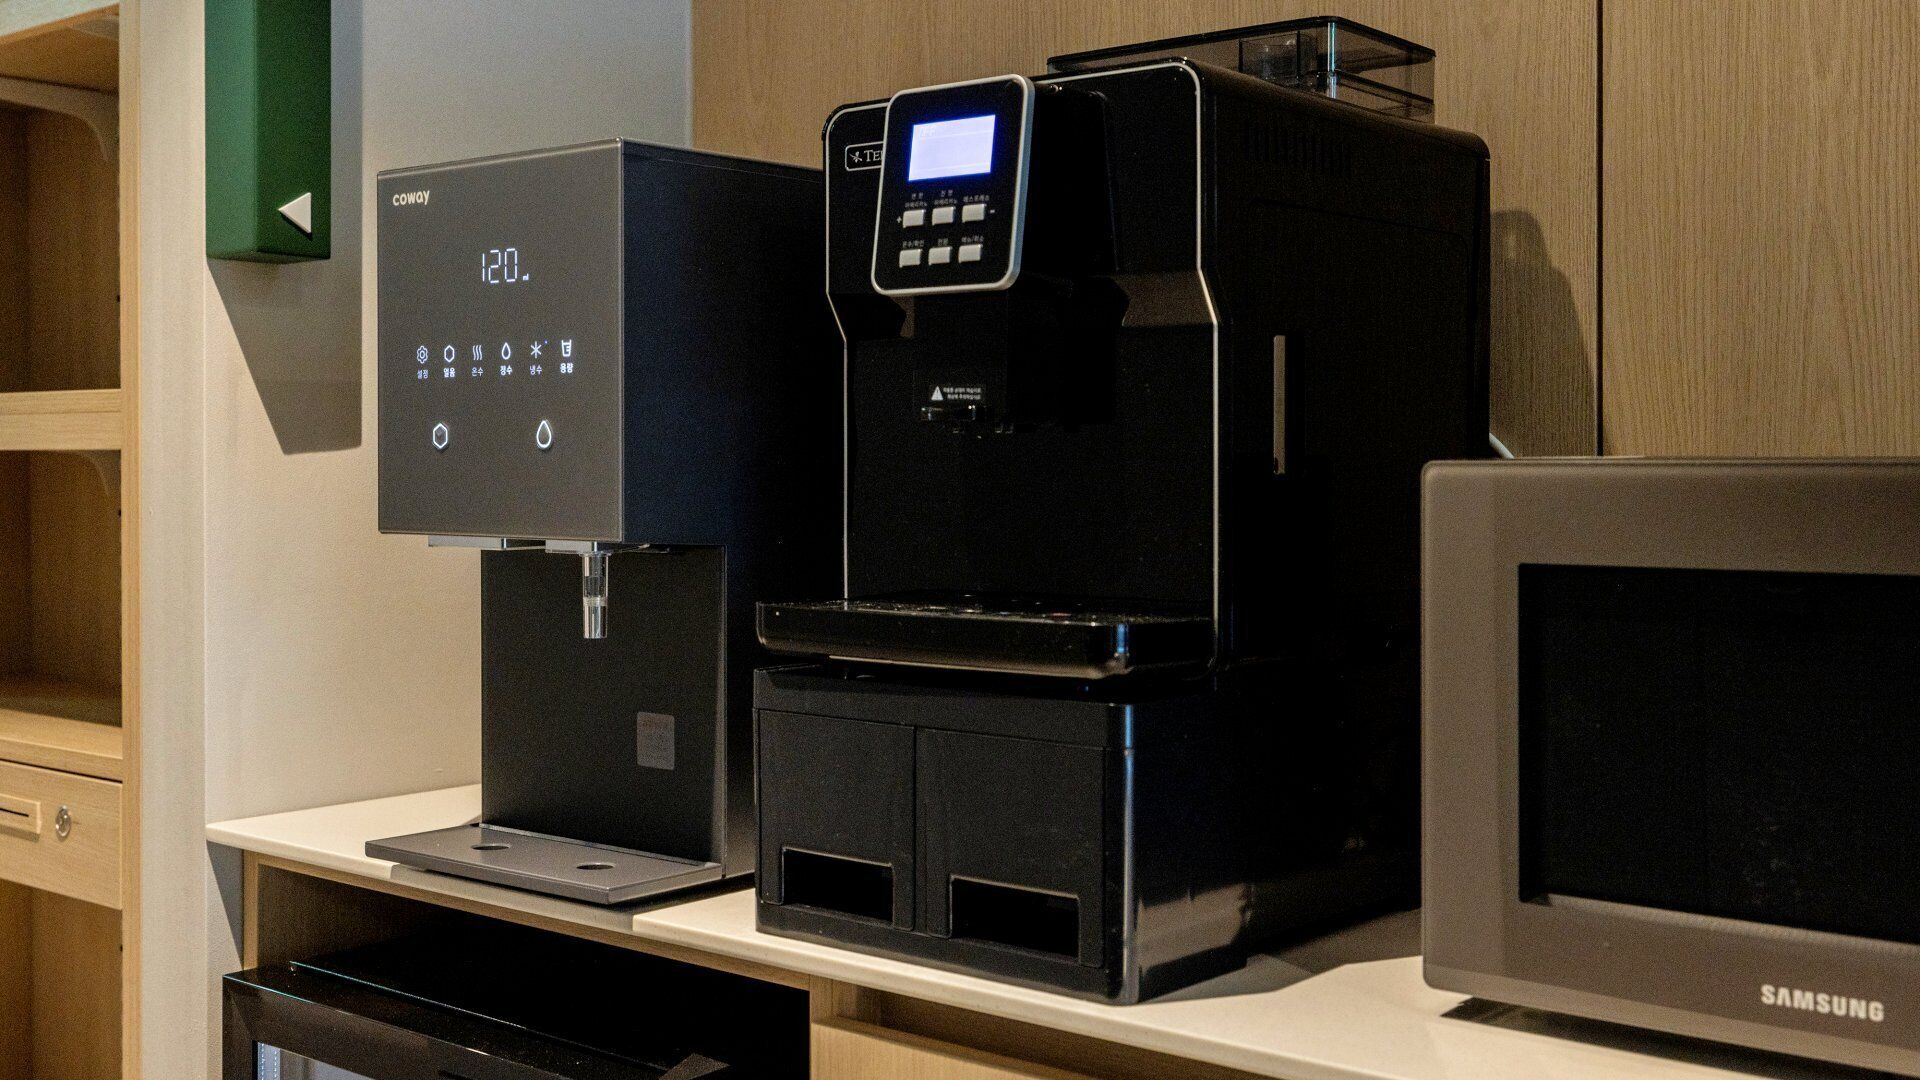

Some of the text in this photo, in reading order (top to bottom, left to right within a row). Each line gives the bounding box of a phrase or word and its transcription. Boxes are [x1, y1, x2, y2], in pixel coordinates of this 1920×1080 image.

[392, 190, 430, 206] coway
[482, 247, 518, 283] 120
[471, 367, 484, 377] 온수
[529, 365, 543, 375] 냉수
[1761, 984, 1885, 1022] SAMSUNG
